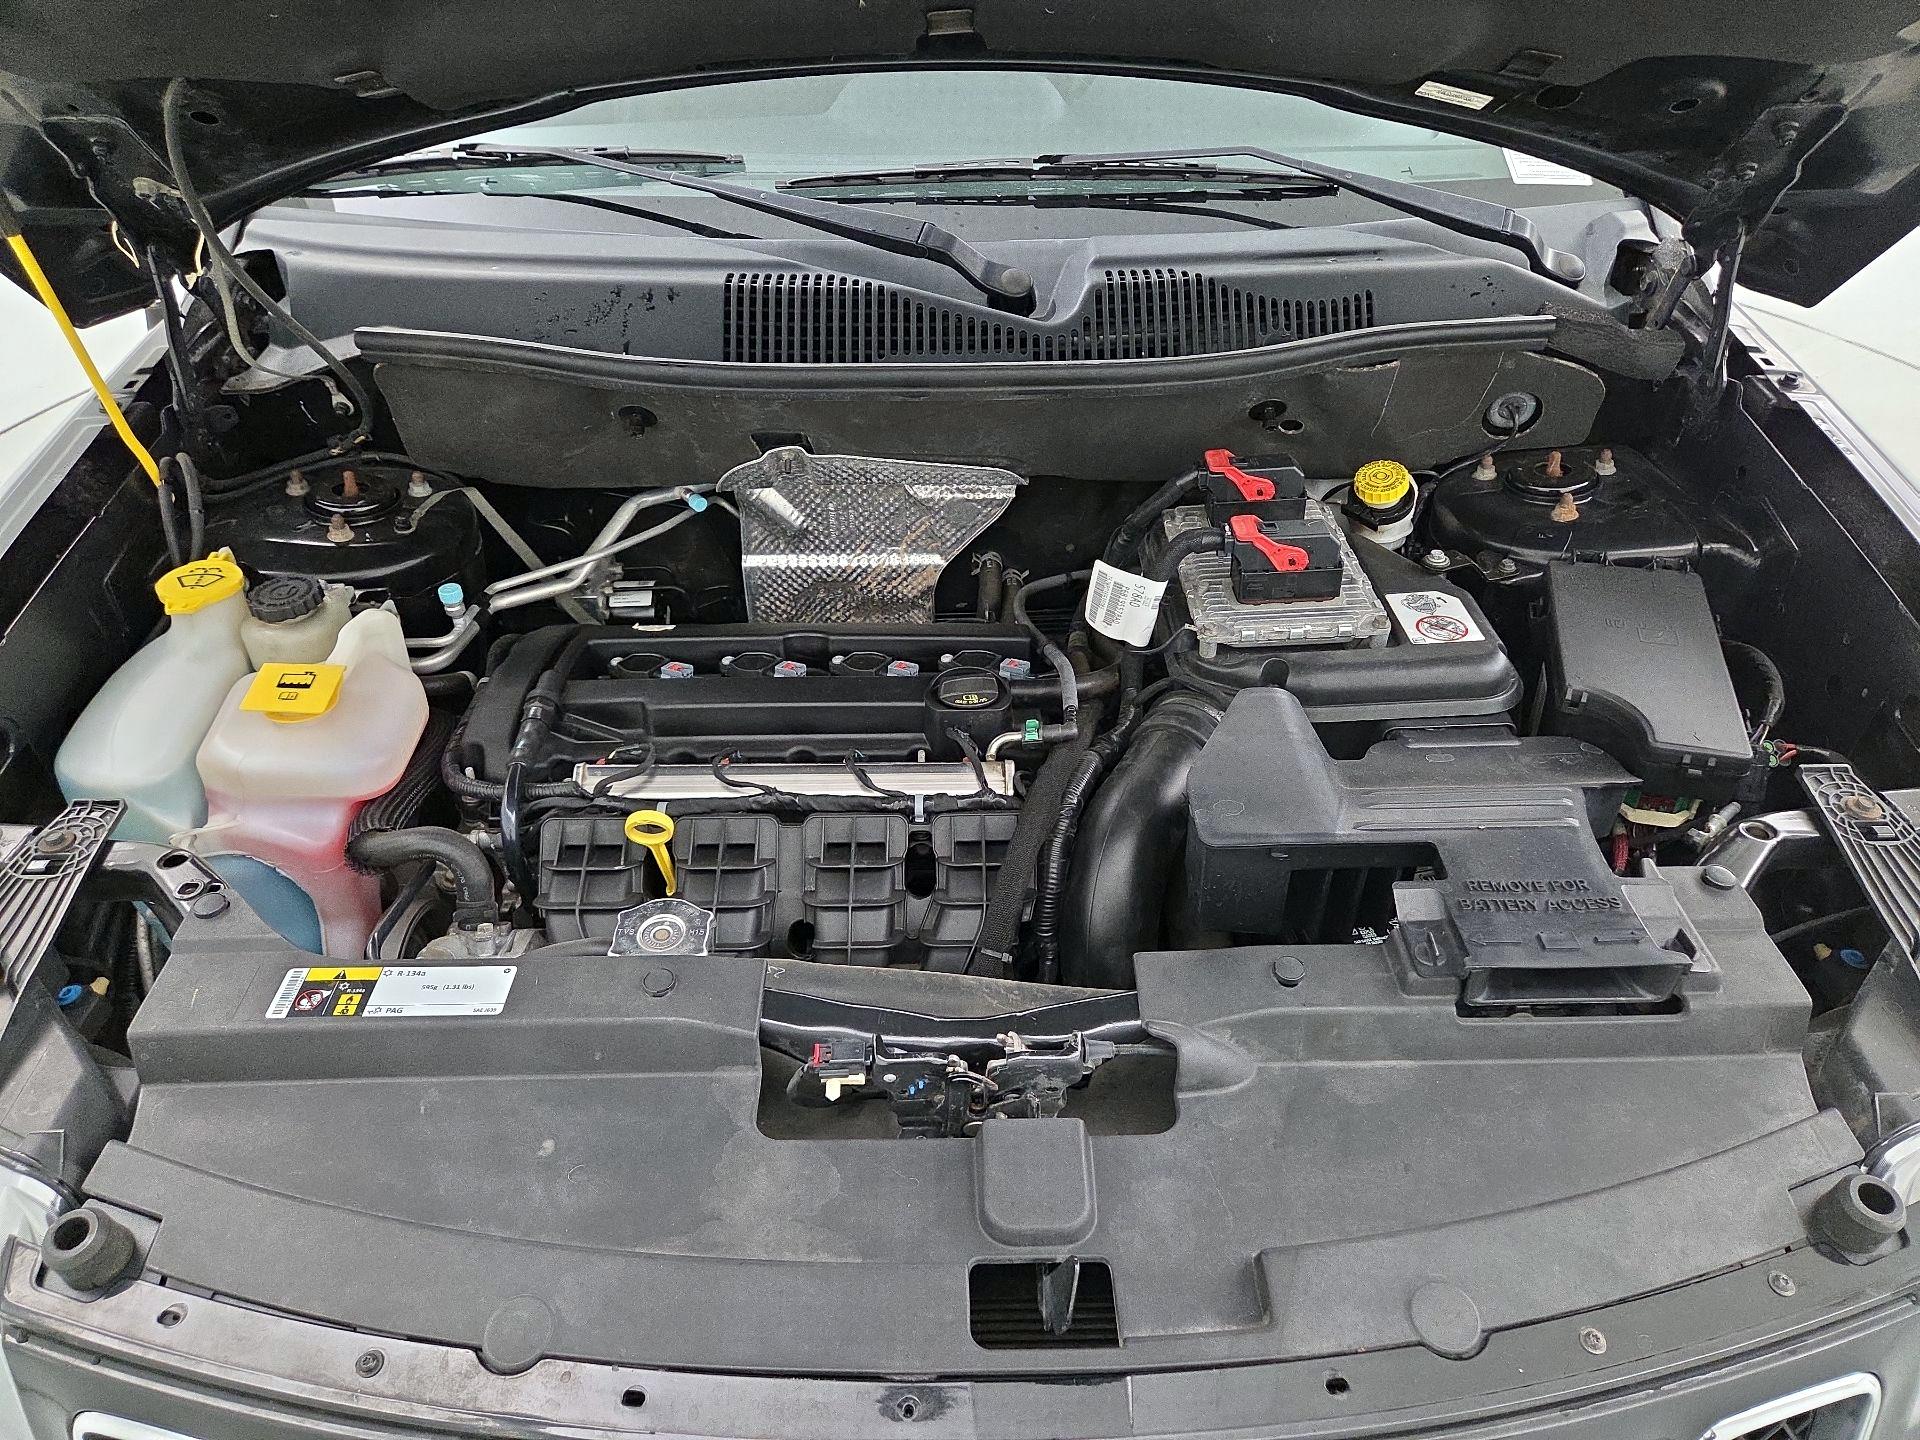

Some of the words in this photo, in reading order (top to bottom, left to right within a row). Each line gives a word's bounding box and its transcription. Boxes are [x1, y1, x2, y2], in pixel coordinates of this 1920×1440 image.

[1465, 878, 1547, 893] REMOVE
[1550, 878, 1591, 893] FOR
[1458, 897, 1539, 912] BATTERY
[1548, 896, 1623, 911] ACCESS
